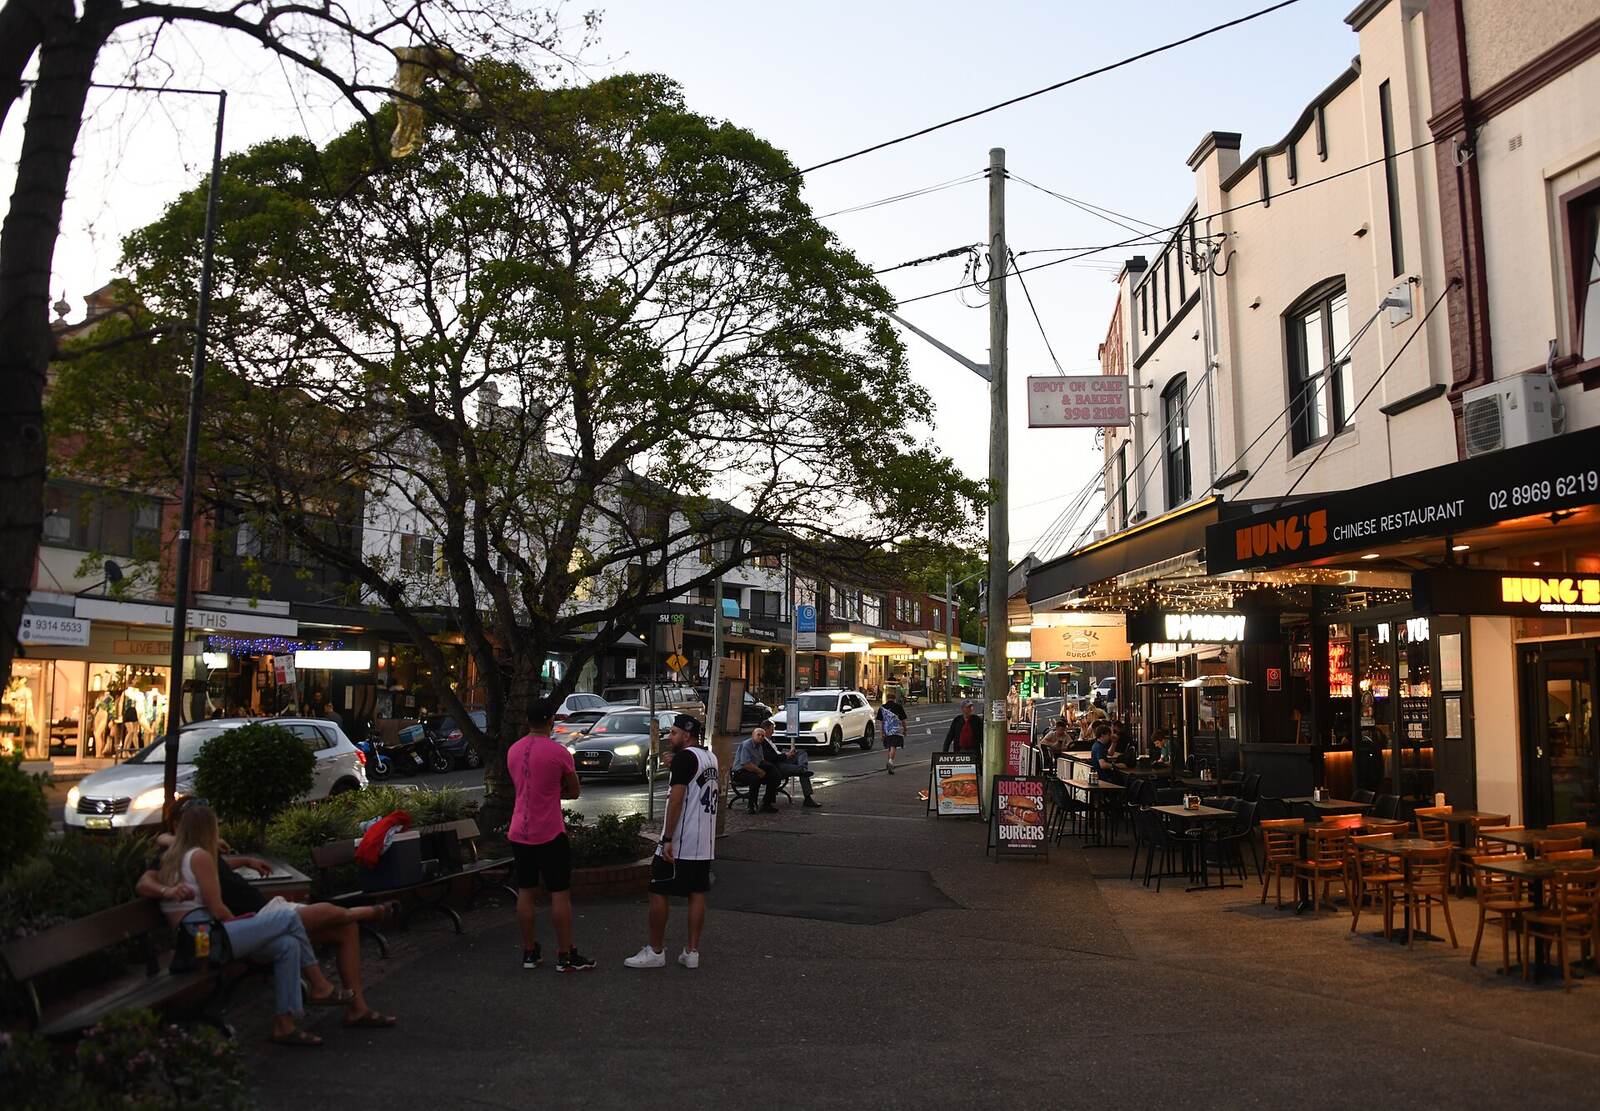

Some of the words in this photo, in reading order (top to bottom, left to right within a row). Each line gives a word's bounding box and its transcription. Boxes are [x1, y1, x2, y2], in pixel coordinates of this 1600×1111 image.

[1033, 381, 1064, 392] SPOT
[1069, 381, 1085, 391] ON
[1091, 380, 1123, 391] CAKE
[1061, 394, 1071, 405] &
[1075, 393, 1122, 405] BAKERY
[1236, 509, 1327, 560] HUNG'S
[1333, 517, 1377, 541] CHINESE
[1381, 500, 1465, 532] RESTAURANT
[1489, 490, 1507, 510] 02
[1512, 481, 1551, 506] 8969
[1556, 471, 1598, 497] 6219
[35, 619, 58, 631] 9314
[60, 621, 82, 633] 5533
[199, 612, 227, 628] THIS
[1066, 650, 1097, 658] BURGER
[999, 781, 1043, 795] BURGERS
[999, 826, 1044, 840] BURGERS
